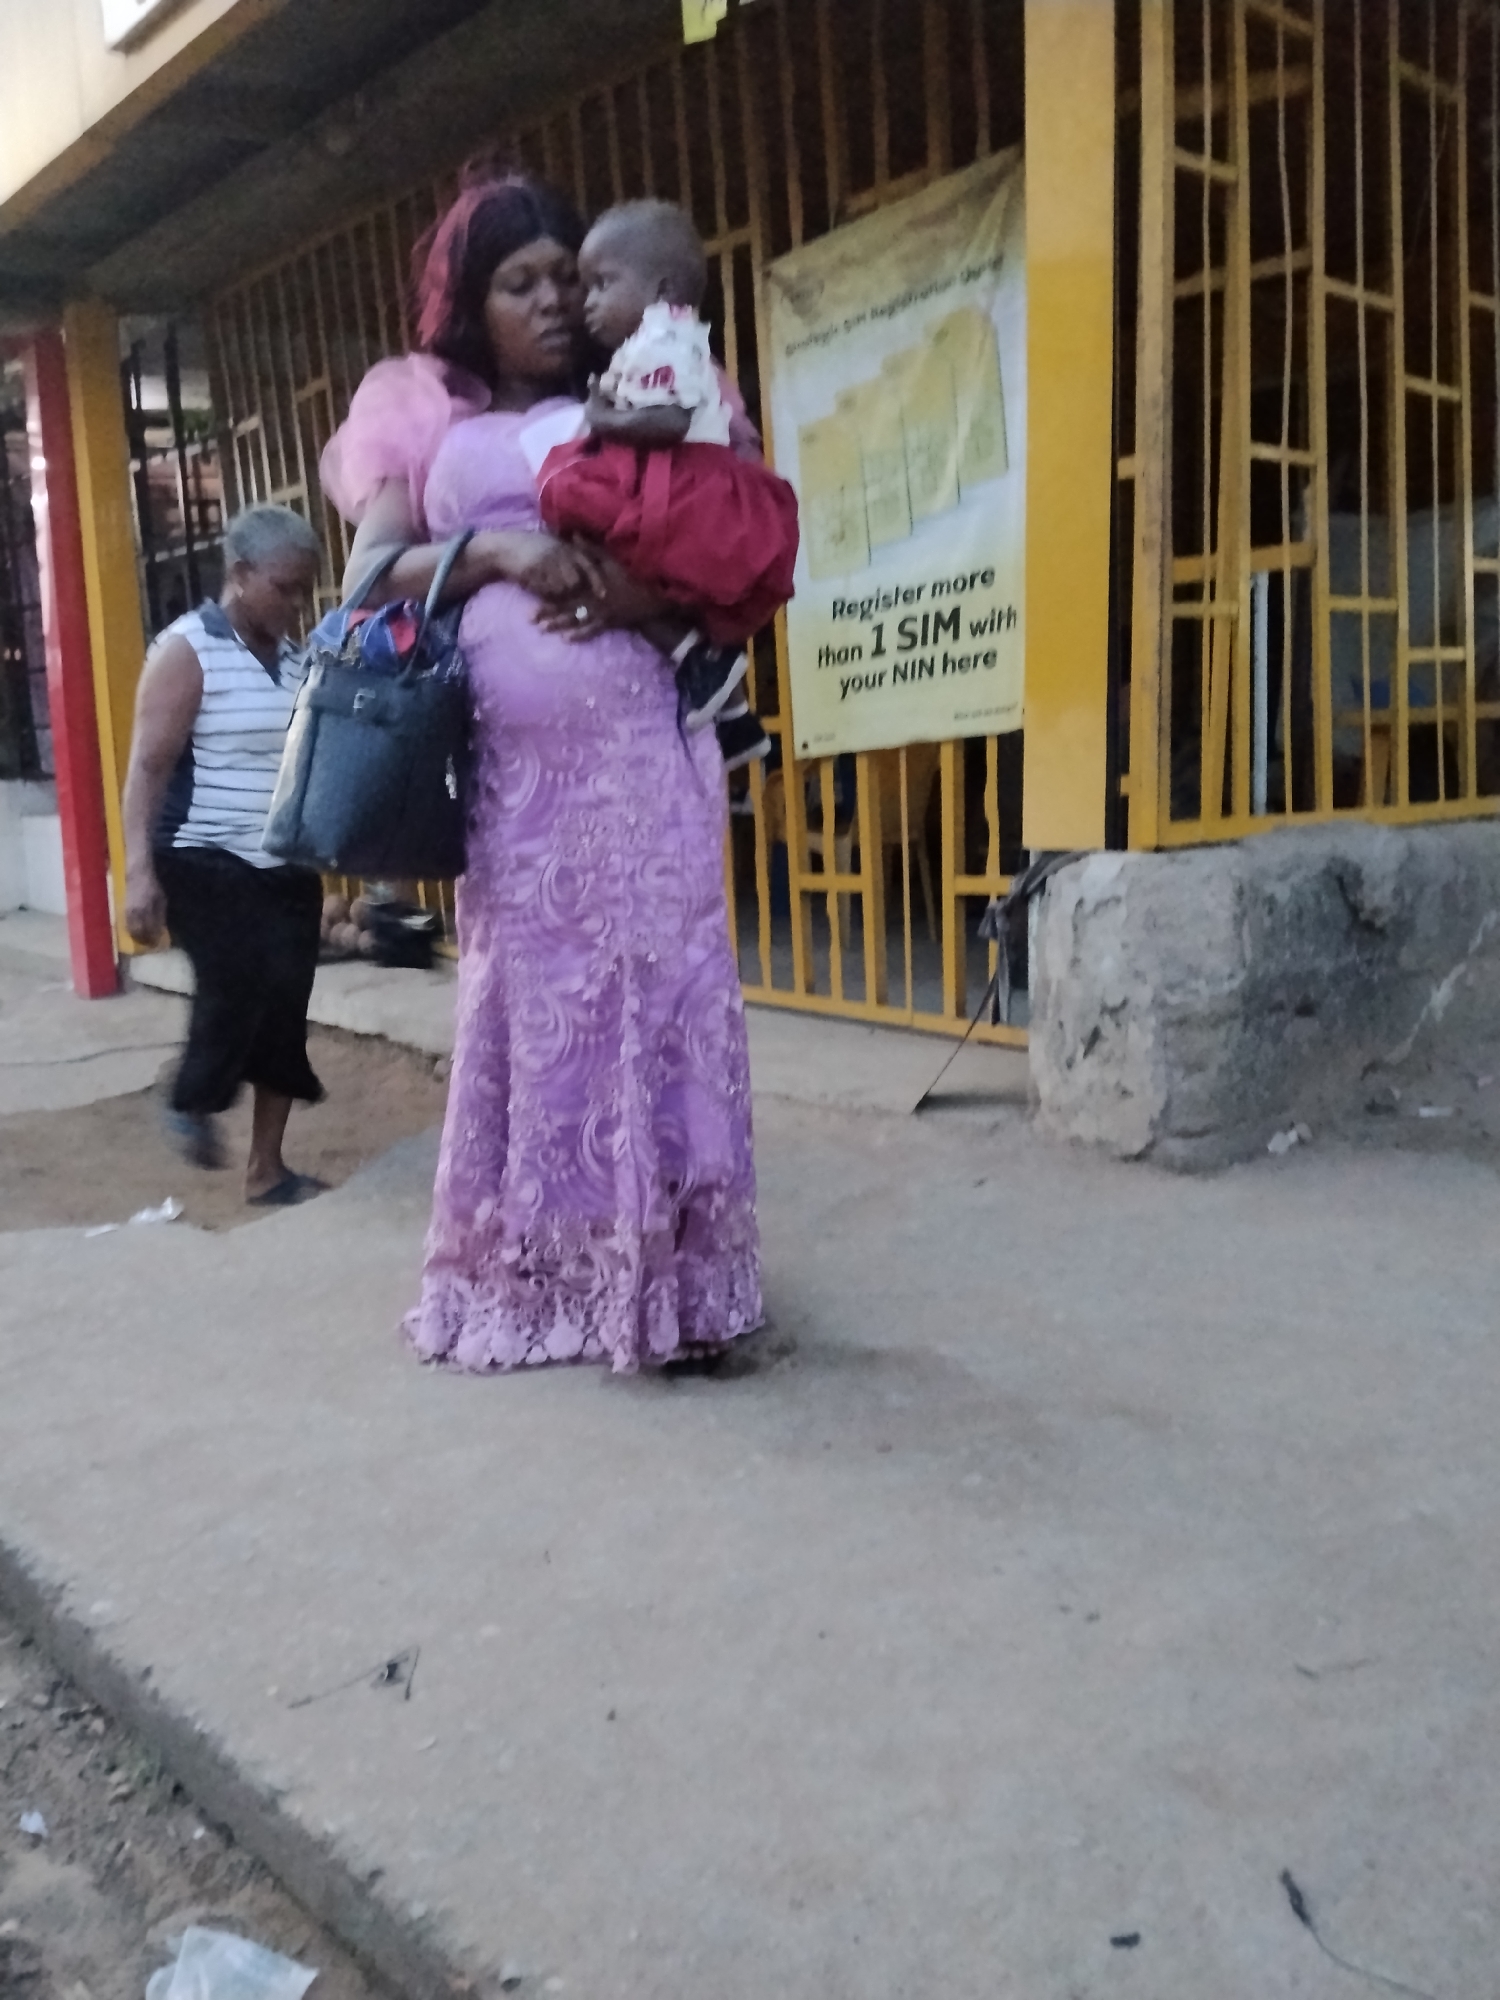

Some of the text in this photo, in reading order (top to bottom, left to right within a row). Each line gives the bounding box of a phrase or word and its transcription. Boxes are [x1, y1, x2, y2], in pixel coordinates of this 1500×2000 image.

[832, 567, 995, 621] Register more
[818, 604, 1017, 669] than 1 SIM with
[839, 648, 997, 700] your NIN here
